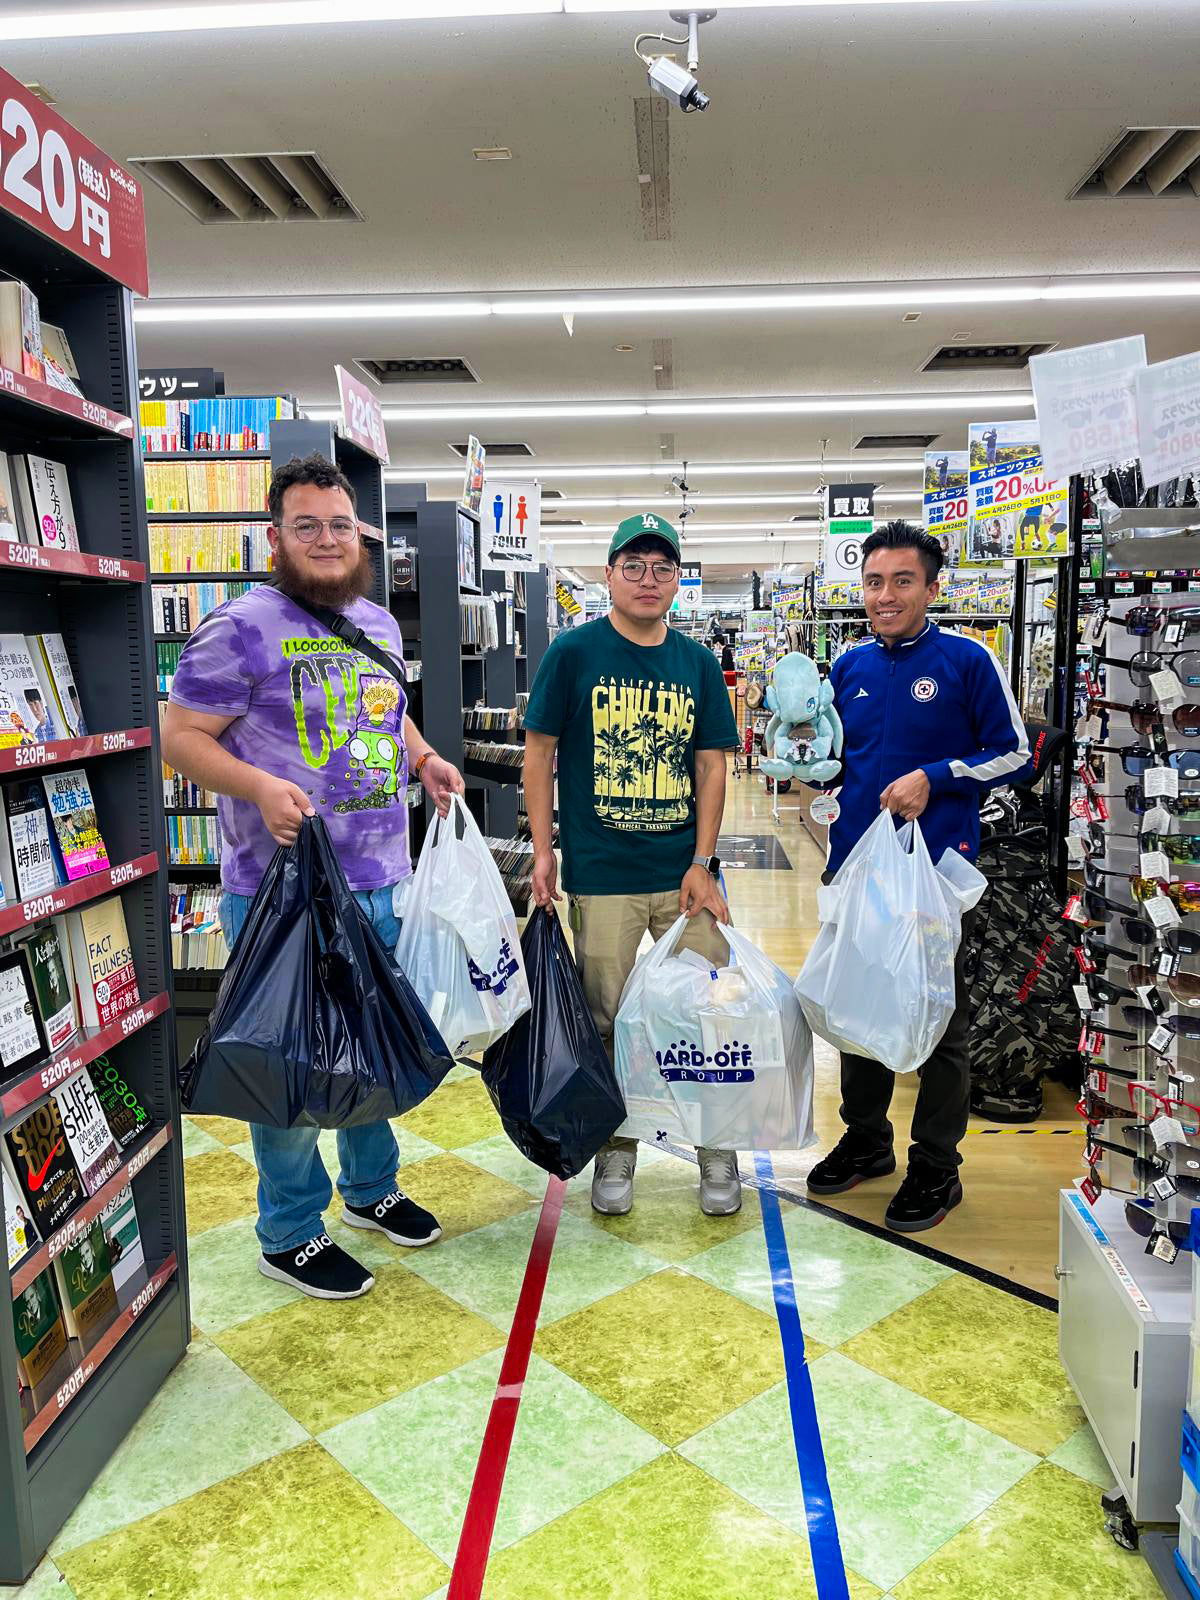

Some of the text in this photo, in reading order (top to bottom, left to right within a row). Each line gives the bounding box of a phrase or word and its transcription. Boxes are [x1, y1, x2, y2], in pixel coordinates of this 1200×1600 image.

[0, 98, 111, 259] 20円
[78, 156, 111, 202] (税込)
[83, 403, 107, 427] 520円
[976, 486, 993, 497] 買取
[976, 497, 993, 507] 金額
[833, 497, 870, 516] 買取
[641, 513, 659, 529] LA
[9, 544, 38, 567] 520円
[99, 559, 120, 578] 520円
[599, 675, 692, 695] CALIFORNIA
[103, 733, 126, 751] 520円
[15, 745, 46, 767] 520円
[110, 864, 134, 886] 520円
[23, 894, 55, 921] 520円
[89, 935, 112, 960] FACT
[93, 946, 133, 982] FULNESS
[121, 1008, 146, 1035] 520円
[41, 1056, 71, 1089] 520円
[664, 1070, 743, 1082] GROUP
[61, 1074, 91, 1113] LIFE
[11, 1098, 63, 1157] SHOE
[64, 1093, 101, 1139] SHIFT
[127, 1147, 150, 1178] 520円
[48, 1220, 76, 1259] 520円
[132, 1281, 154, 1316] 520円
[57, 1363, 85, 1409] 520円
